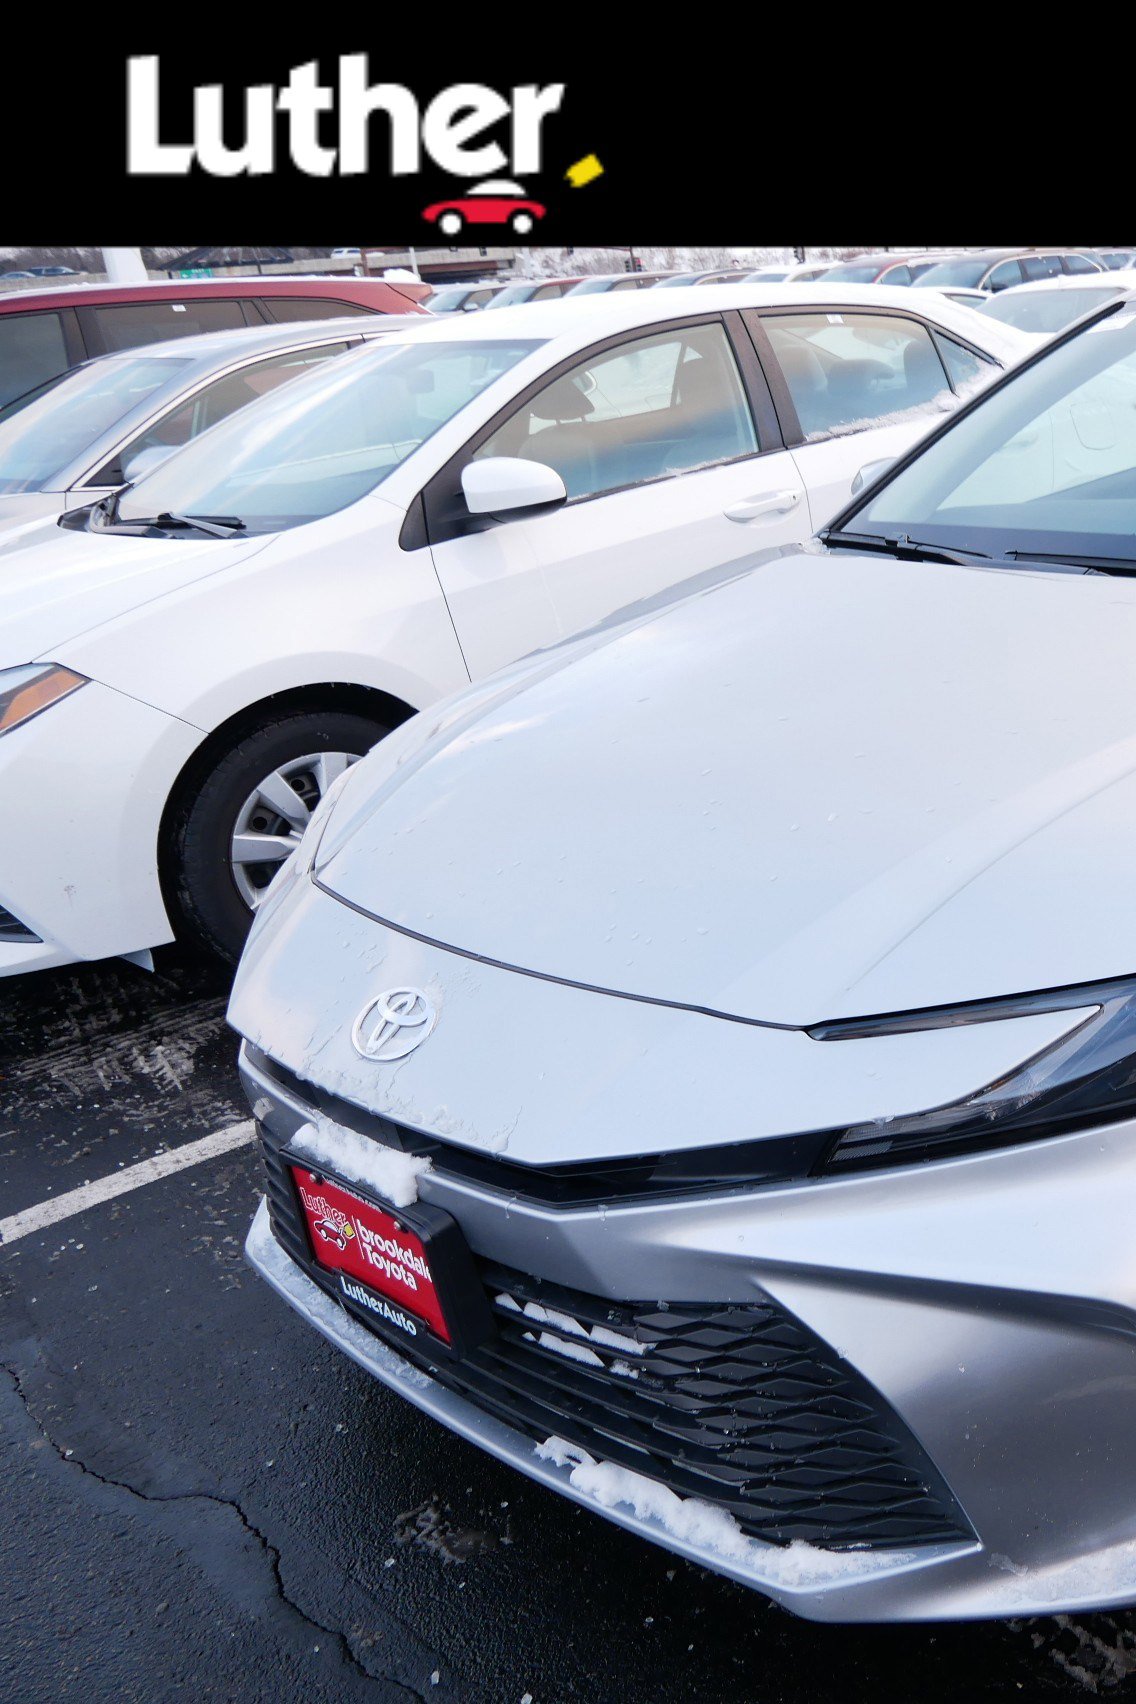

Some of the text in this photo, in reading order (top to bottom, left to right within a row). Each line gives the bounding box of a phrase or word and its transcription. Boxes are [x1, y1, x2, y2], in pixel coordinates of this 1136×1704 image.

[299, 1187, 348, 1226] Luther
[362, 1241, 418, 1291] Toyota
[340, 1275, 417, 1336] LutherAuto
